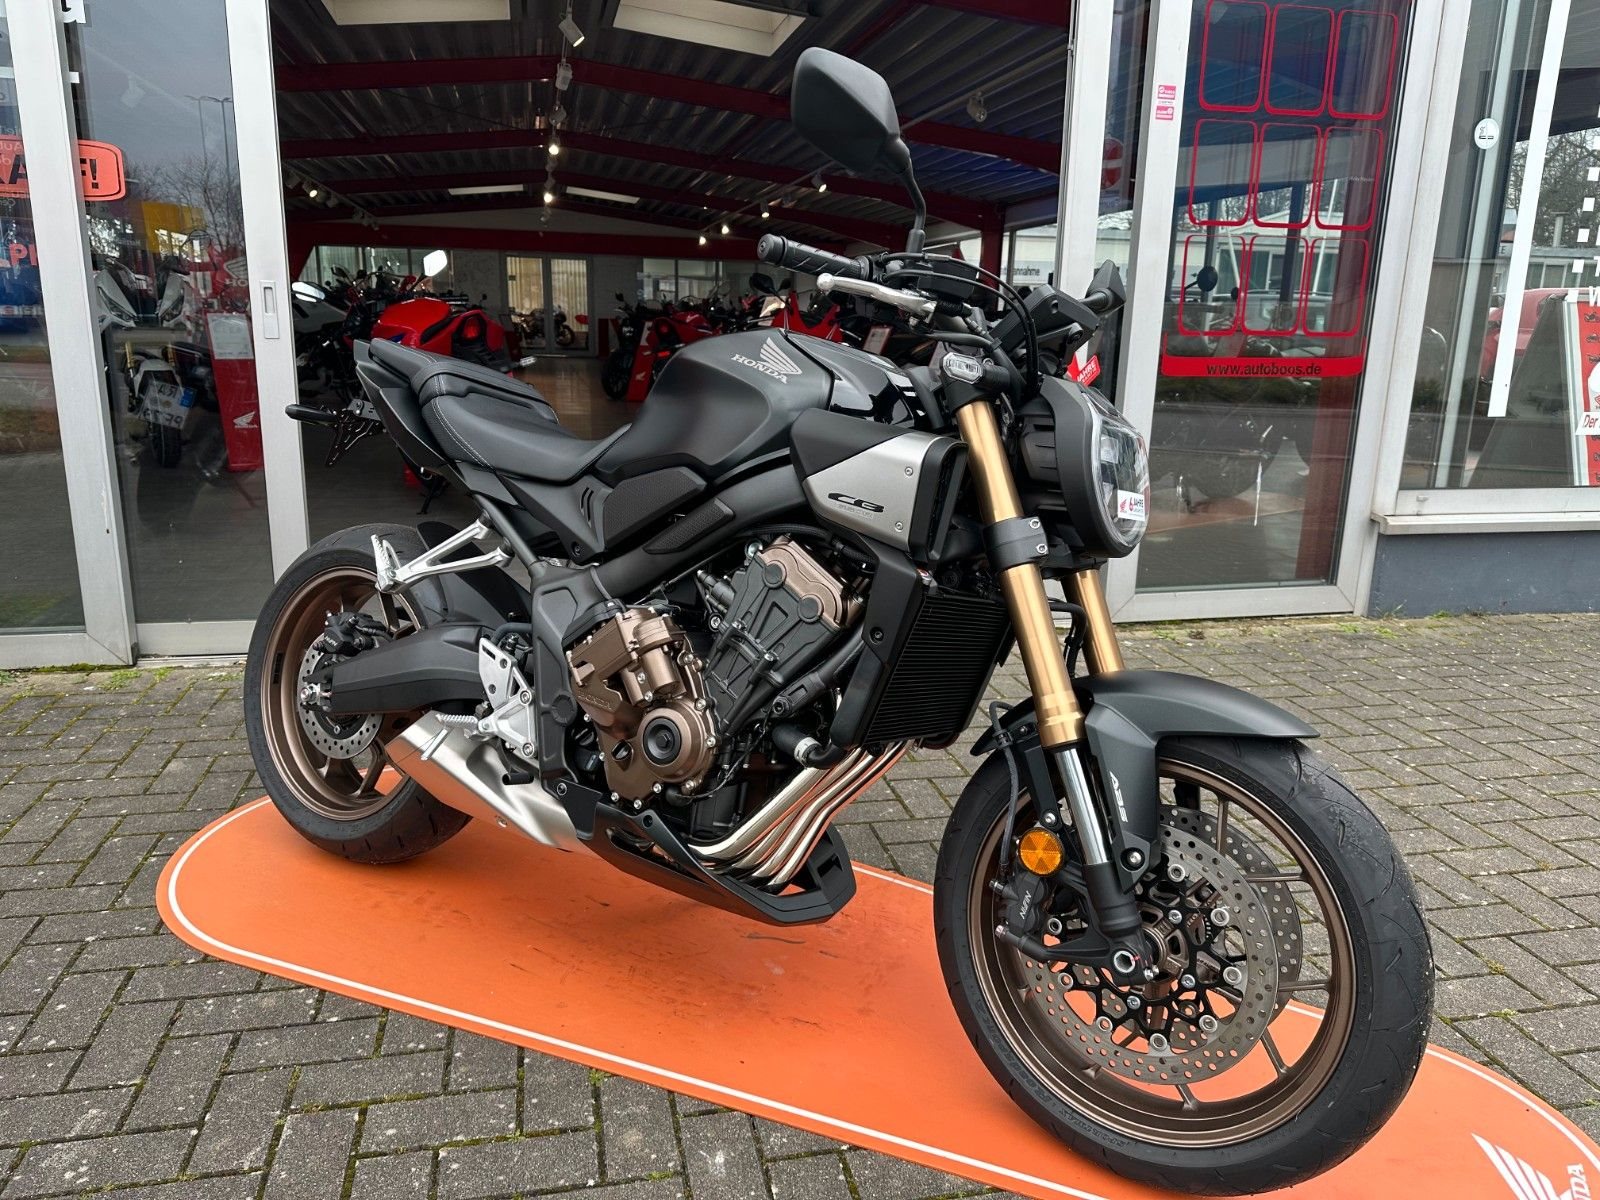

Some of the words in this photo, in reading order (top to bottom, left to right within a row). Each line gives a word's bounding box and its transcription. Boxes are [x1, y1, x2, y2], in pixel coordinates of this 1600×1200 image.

[730, 353, 788, 384] HONDA
[1206, 362, 1322, 376] www.autoboos.de
[1583, 414, 1598, 429] Der
[827, 492, 885, 513] CB
[1109, 770, 1129, 823] ABS
